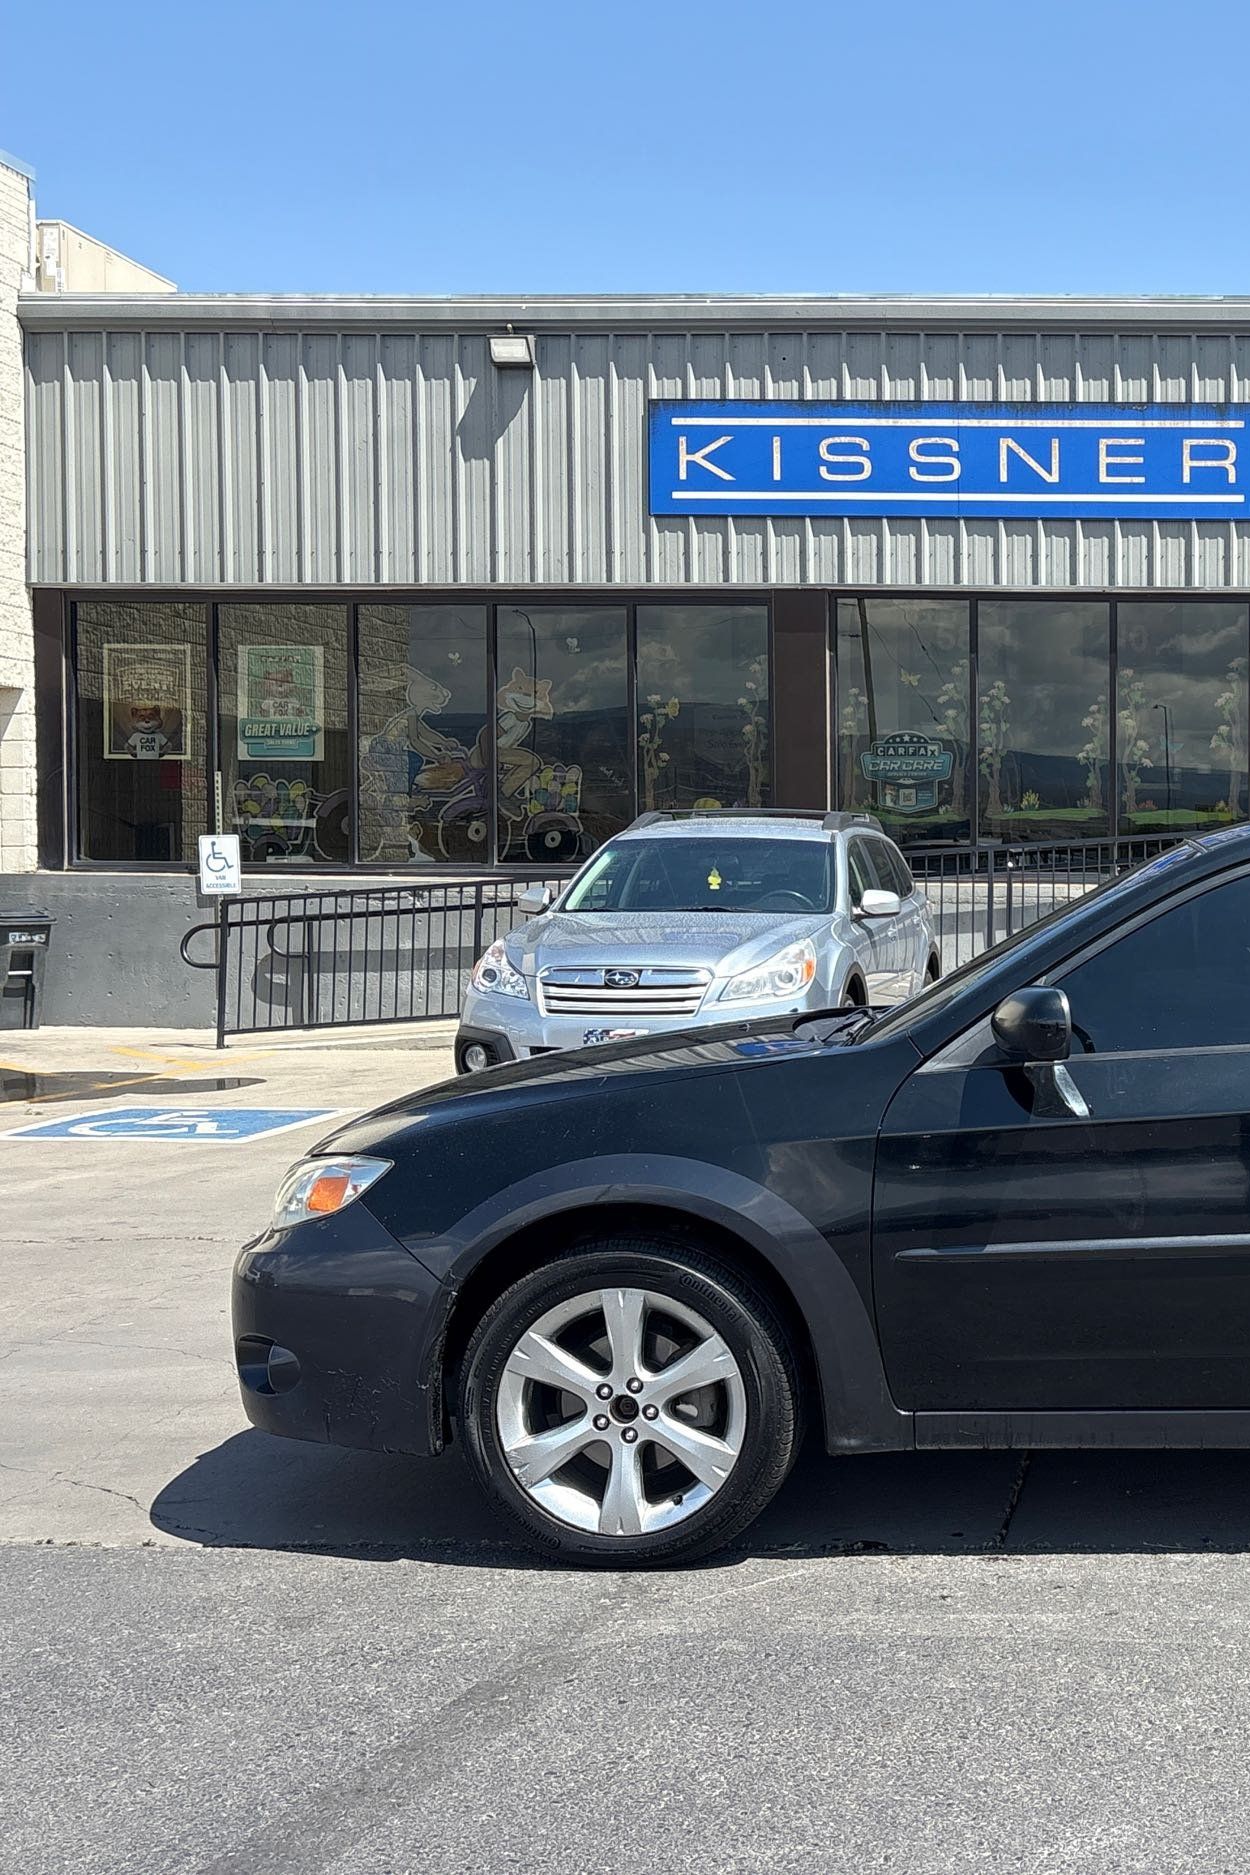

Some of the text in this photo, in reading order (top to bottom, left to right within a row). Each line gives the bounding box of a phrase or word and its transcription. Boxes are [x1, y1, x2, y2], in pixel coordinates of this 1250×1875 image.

[678, 435, 1238, 483] KISSNER
[272, 701, 289, 709] CAR
[273, 709, 289, 717] FOX
[244, 723, 310, 737] GREAT VALUE
[139, 737, 156, 745] CAR
[140, 744, 156, 753] FOX
[876, 745, 939, 757] CARFAX
[869, 760, 944, 771] CAR CARE
